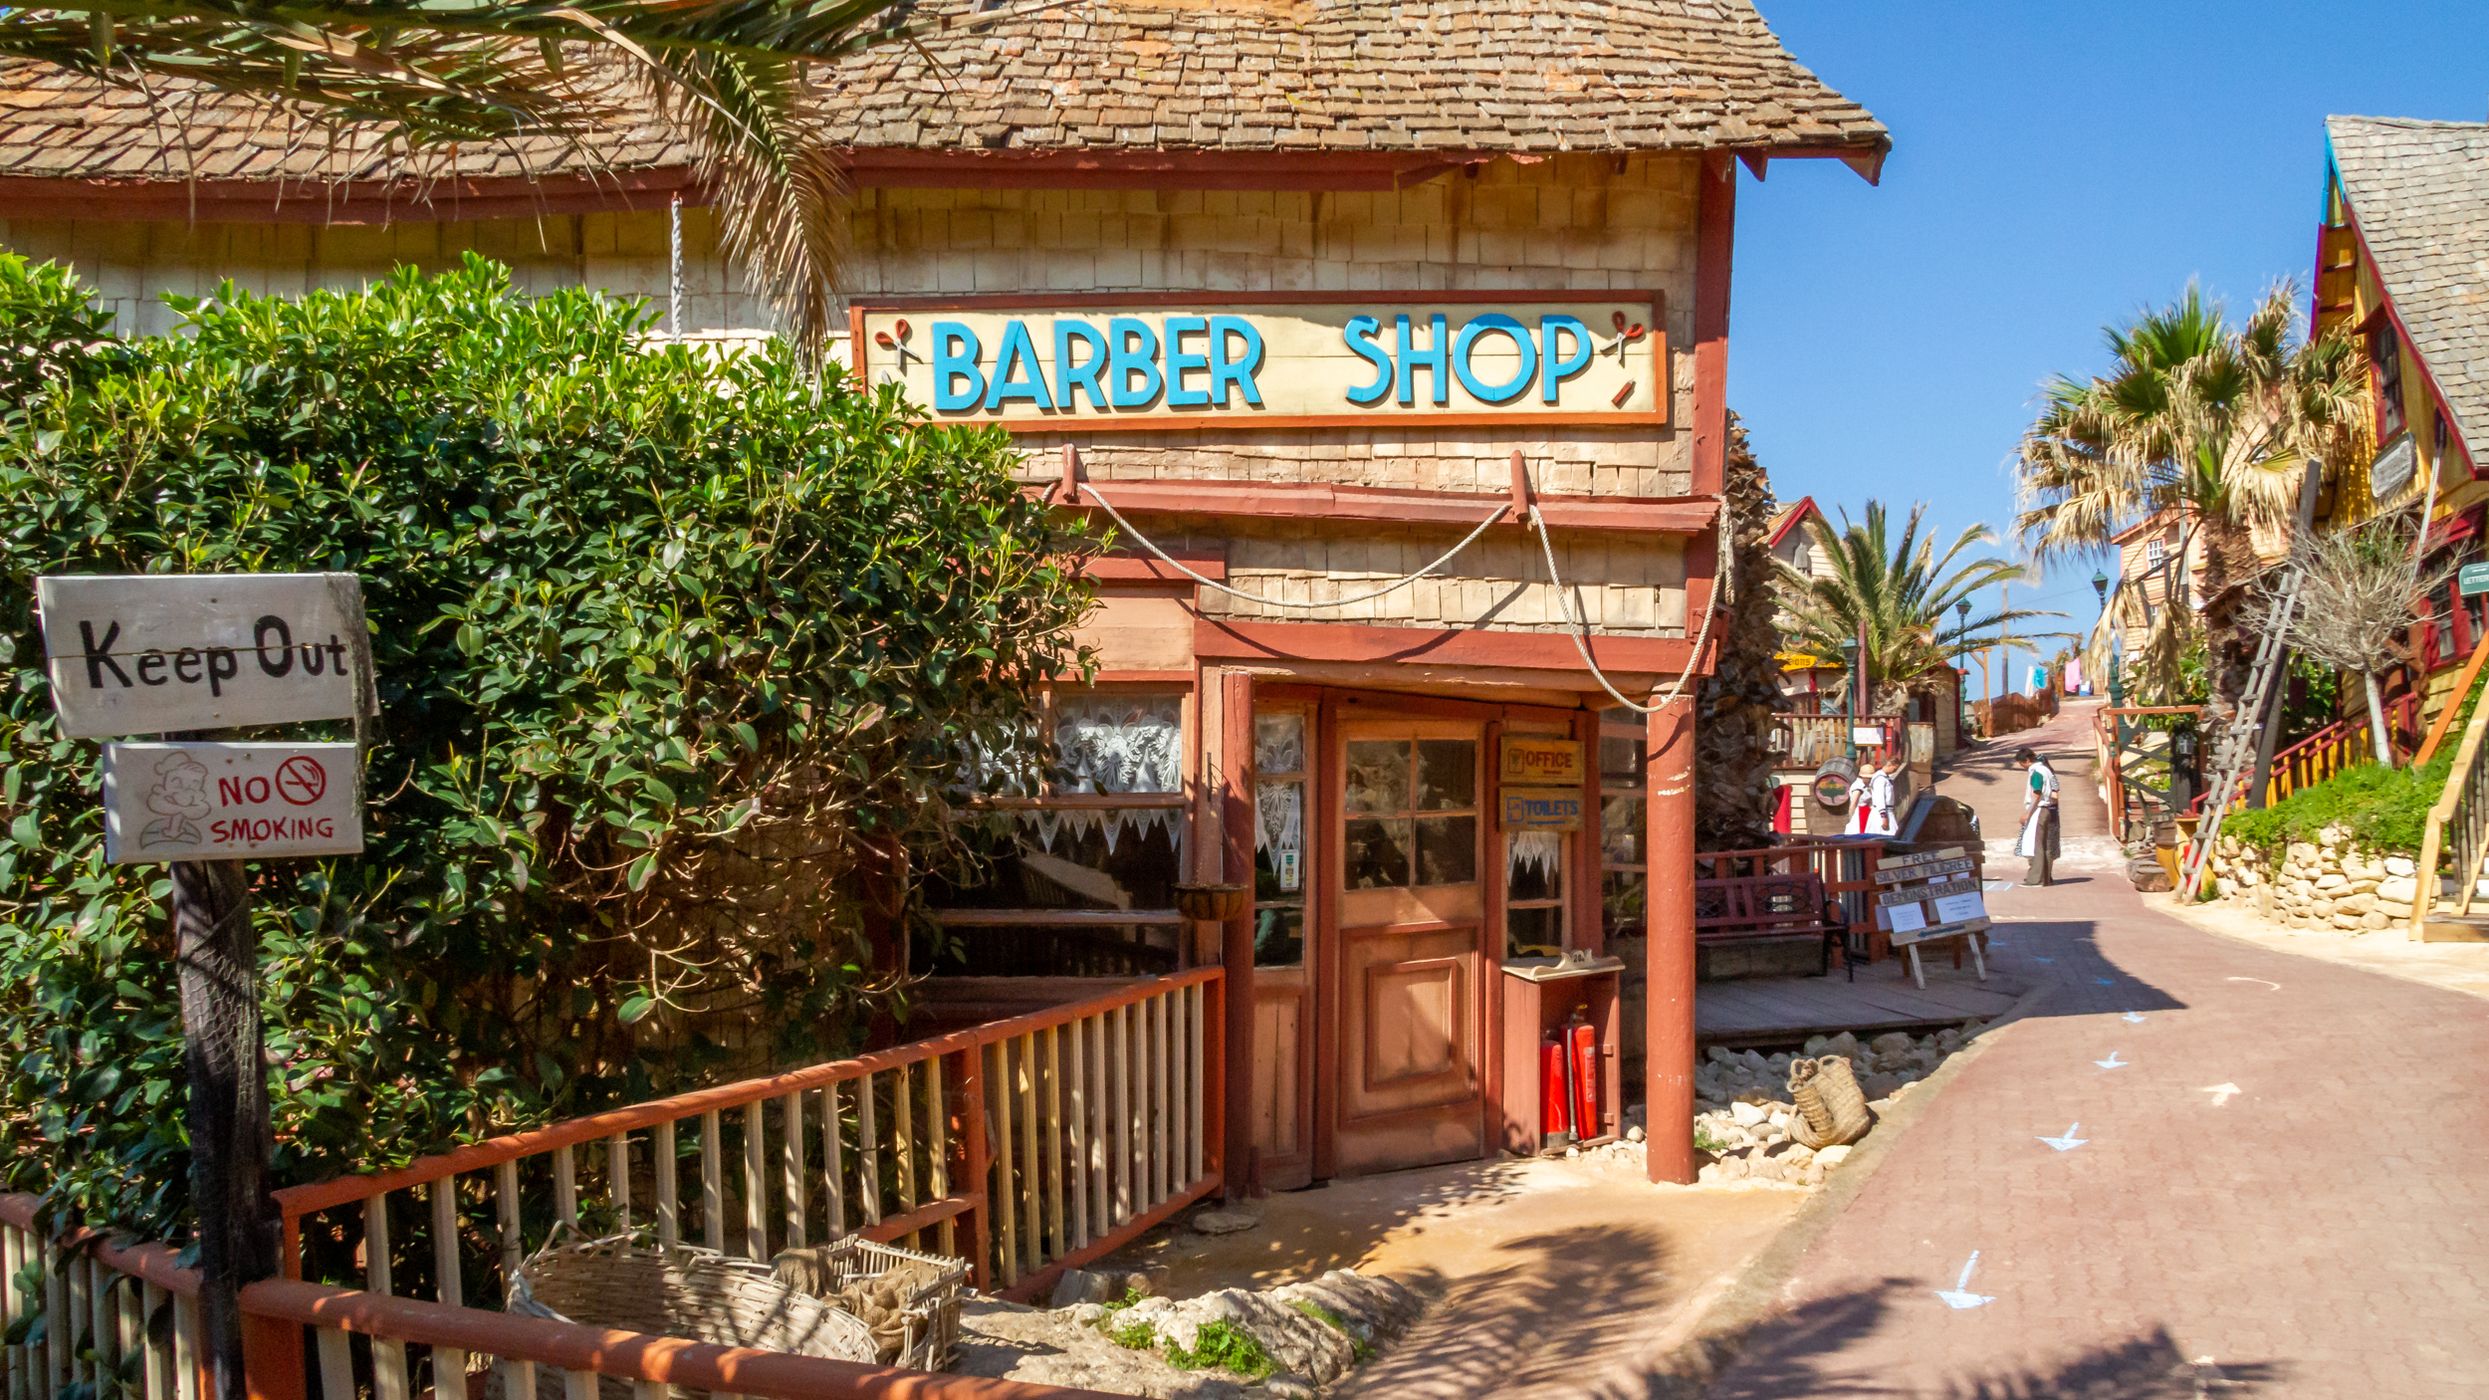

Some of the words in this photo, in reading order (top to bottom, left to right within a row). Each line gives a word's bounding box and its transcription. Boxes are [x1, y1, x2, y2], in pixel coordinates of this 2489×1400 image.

[931, 314, 1265, 413] BARBER
[1344, 313, 1594, 406] SHOP
[78, 619, 239, 698] Keep
[253, 614, 349, 679] Out
[1526, 751, 1572, 768] OFFICE
[218, 776, 271, 808] NO
[1525, 800, 1578, 816] TOILETS
[210, 816, 335, 845] SMOKING
[1903, 852, 1940, 864] FREE
[1876, 868, 1916, 882] SILVER
[1922, 859, 1973, 874] FILIGREE
[1882, 880, 1977, 904] DEMONSTRATION
